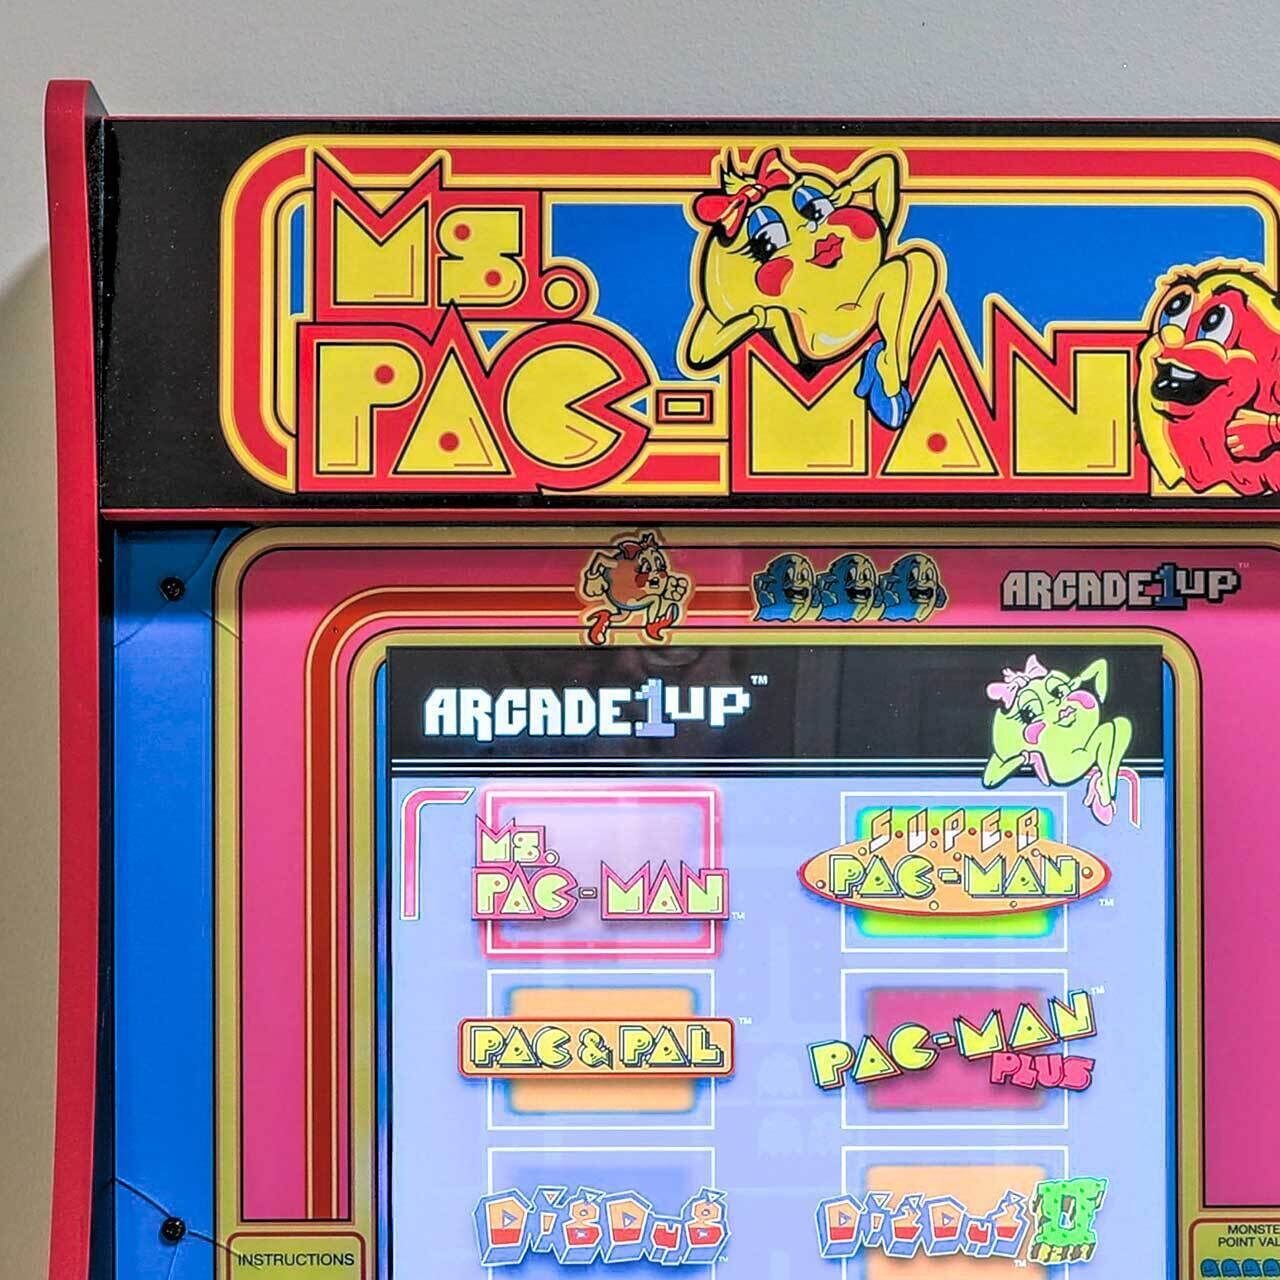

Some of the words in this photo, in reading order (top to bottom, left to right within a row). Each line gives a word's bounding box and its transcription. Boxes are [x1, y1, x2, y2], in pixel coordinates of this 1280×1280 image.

[300, 308, 1145, 493] PAC-MAN
[472, 861, 729, 920] PAC-MAN
[829, 855, 1080, 898] PAC-MAN
[470, 1025, 573, 1068] PAC
[577, 1029, 613, 1070] &
[620, 1025, 724, 1067] PAL
[807, 990, 1097, 1090] PAC-MAN
[990, 1052, 1095, 1091] PLUS
[238, 1253, 355, 1266] INSTRUCTIONS
[1218, 1237, 1256, 1247] POINT
